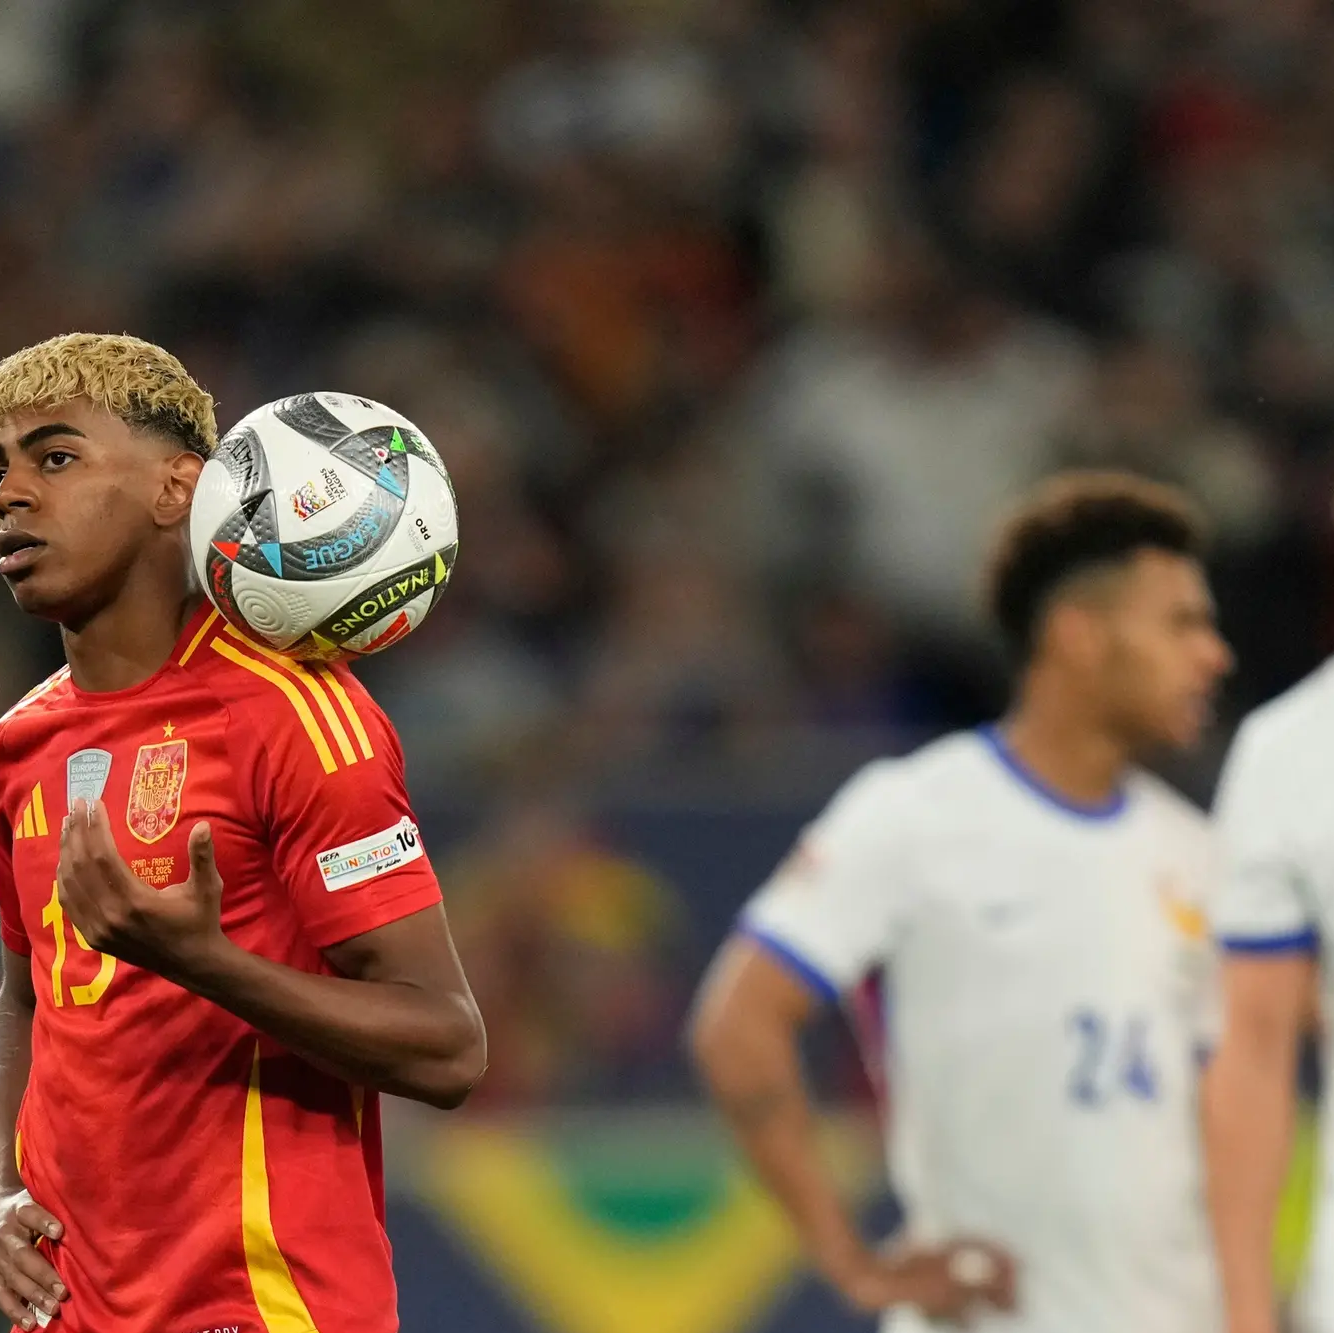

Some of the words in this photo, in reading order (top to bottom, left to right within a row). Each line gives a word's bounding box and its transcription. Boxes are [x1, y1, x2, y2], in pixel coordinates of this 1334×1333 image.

[320, 468, 343, 501] NATIONS
[303, 506, 390, 570] LEAGUE
[416, 518, 431, 540] PRO
[331, 569, 424, 635] NATIONS
[131, 859, 146, 868] SPAIN
[152, 857, 174, 866] FRANCE
[320, 852, 340, 863] UEFA
[323, 843, 398, 877] FOUNDATION
[396, 828, 416, 852] 10
[139, 867, 153, 876] JUNE
[156, 866, 172, 874] 2025
[1069, 1004, 1160, 1108] 24
